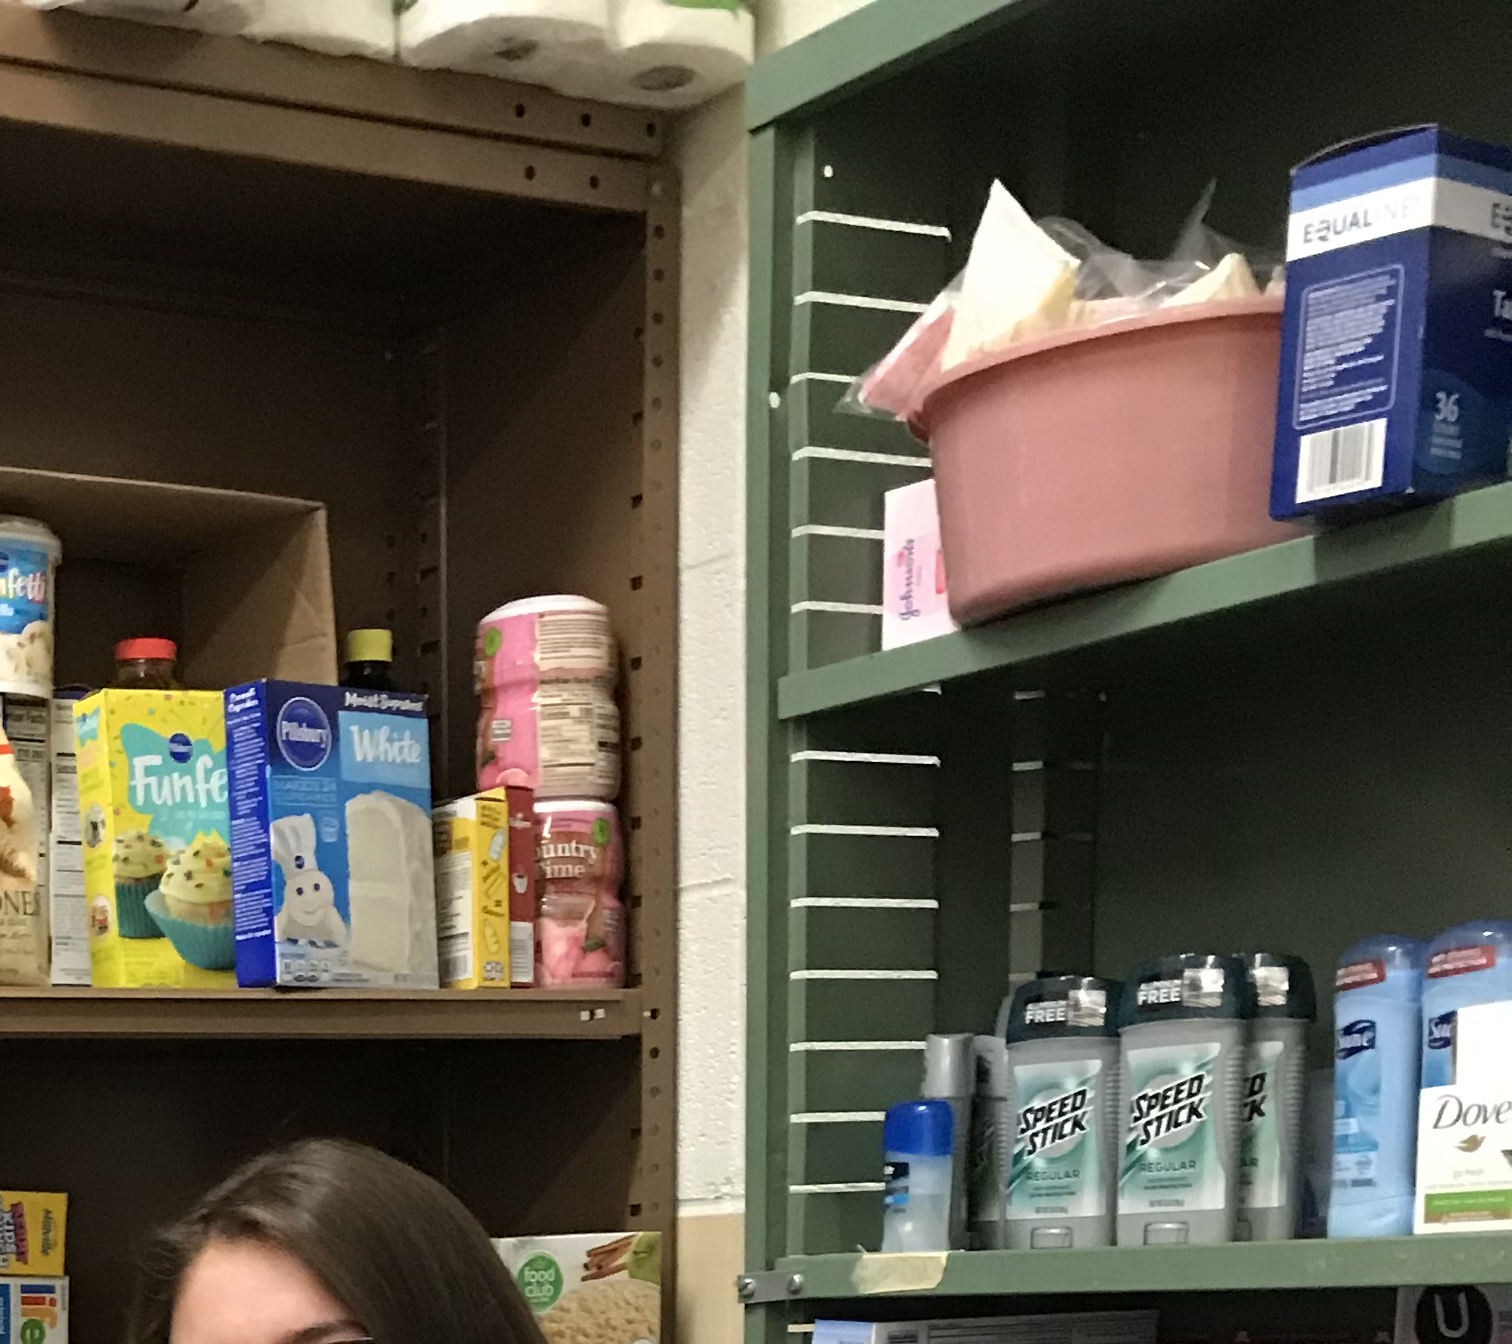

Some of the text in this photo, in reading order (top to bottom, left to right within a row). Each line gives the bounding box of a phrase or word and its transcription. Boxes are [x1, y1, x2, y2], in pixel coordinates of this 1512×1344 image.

[1436, 391, 1459, 421] 36
[349, 724, 422, 764] White
[129, 753, 230, 808] Funfe
[1137, 986, 1182, 1006] FREE
[1025, 1006, 1067, 1024] FREE
[1019, 1088, 1088, 1135] SPEED
[1132, 1072, 1206, 1124] SPEED
[1432, 1093, 1512, 1130] Dove
[1026, 1111, 1090, 1158] STICK
[1138, 1096, 1205, 1148] STICK
[1025, 1168, 1081, 1182] REGULAR
[1139, 1158, 1198, 1174] REGULAR
[524, 1269, 555, 1282] food
[524, 1283, 555, 1298] club
